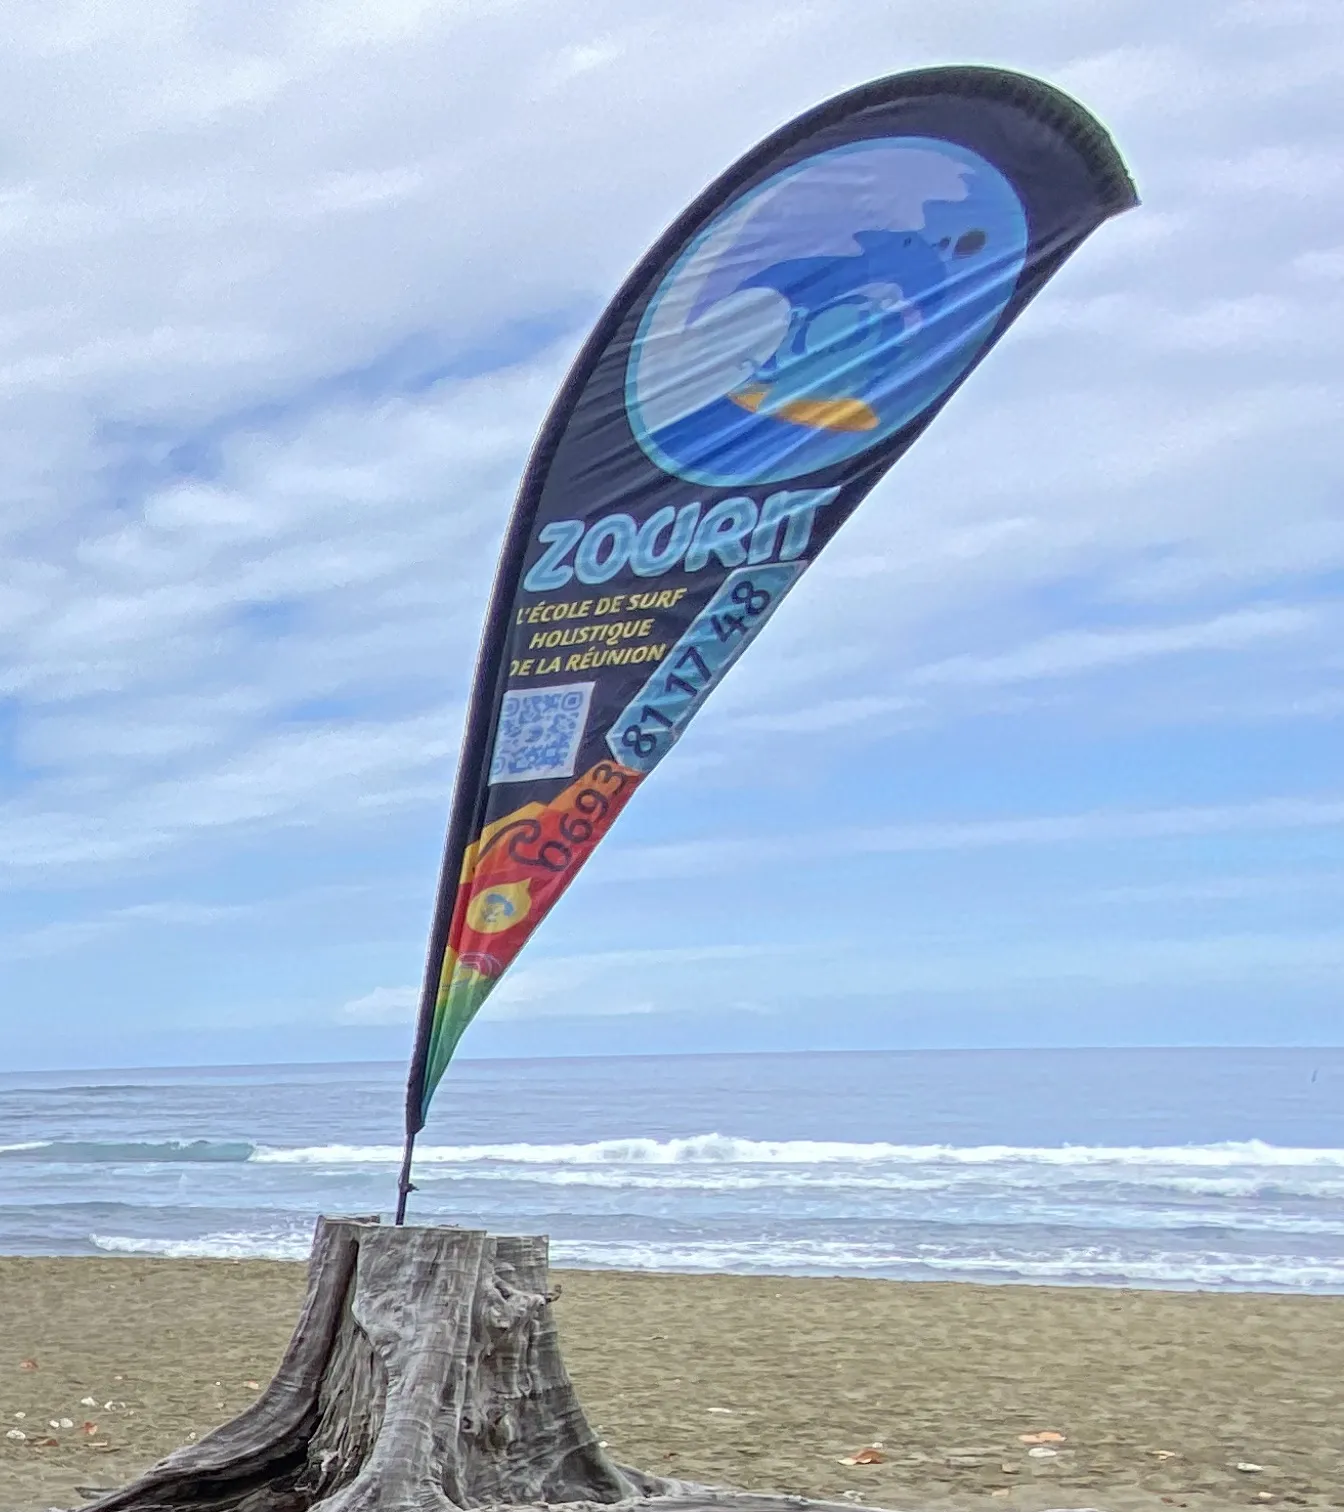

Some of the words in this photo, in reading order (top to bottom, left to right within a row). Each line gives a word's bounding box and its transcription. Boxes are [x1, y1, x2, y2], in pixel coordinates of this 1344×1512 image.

[524, 485, 841, 592] ZOURIT
[515, 600, 593, 625] L'ÉCOLE
[594, 595, 626, 616] DE
[626, 588, 688, 610] SURF
[529, 618, 655, 650] HOLISTIQUE
[509, 658, 534, 677] DE
[535, 656, 561, 675] LA
[565, 644, 668, 672] RÉUNION
[538, 763, 629, 872] 0693
[622, 704, 674, 759] 81
[665, 646, 713, 697] 17
[711, 580, 771, 643] 48
